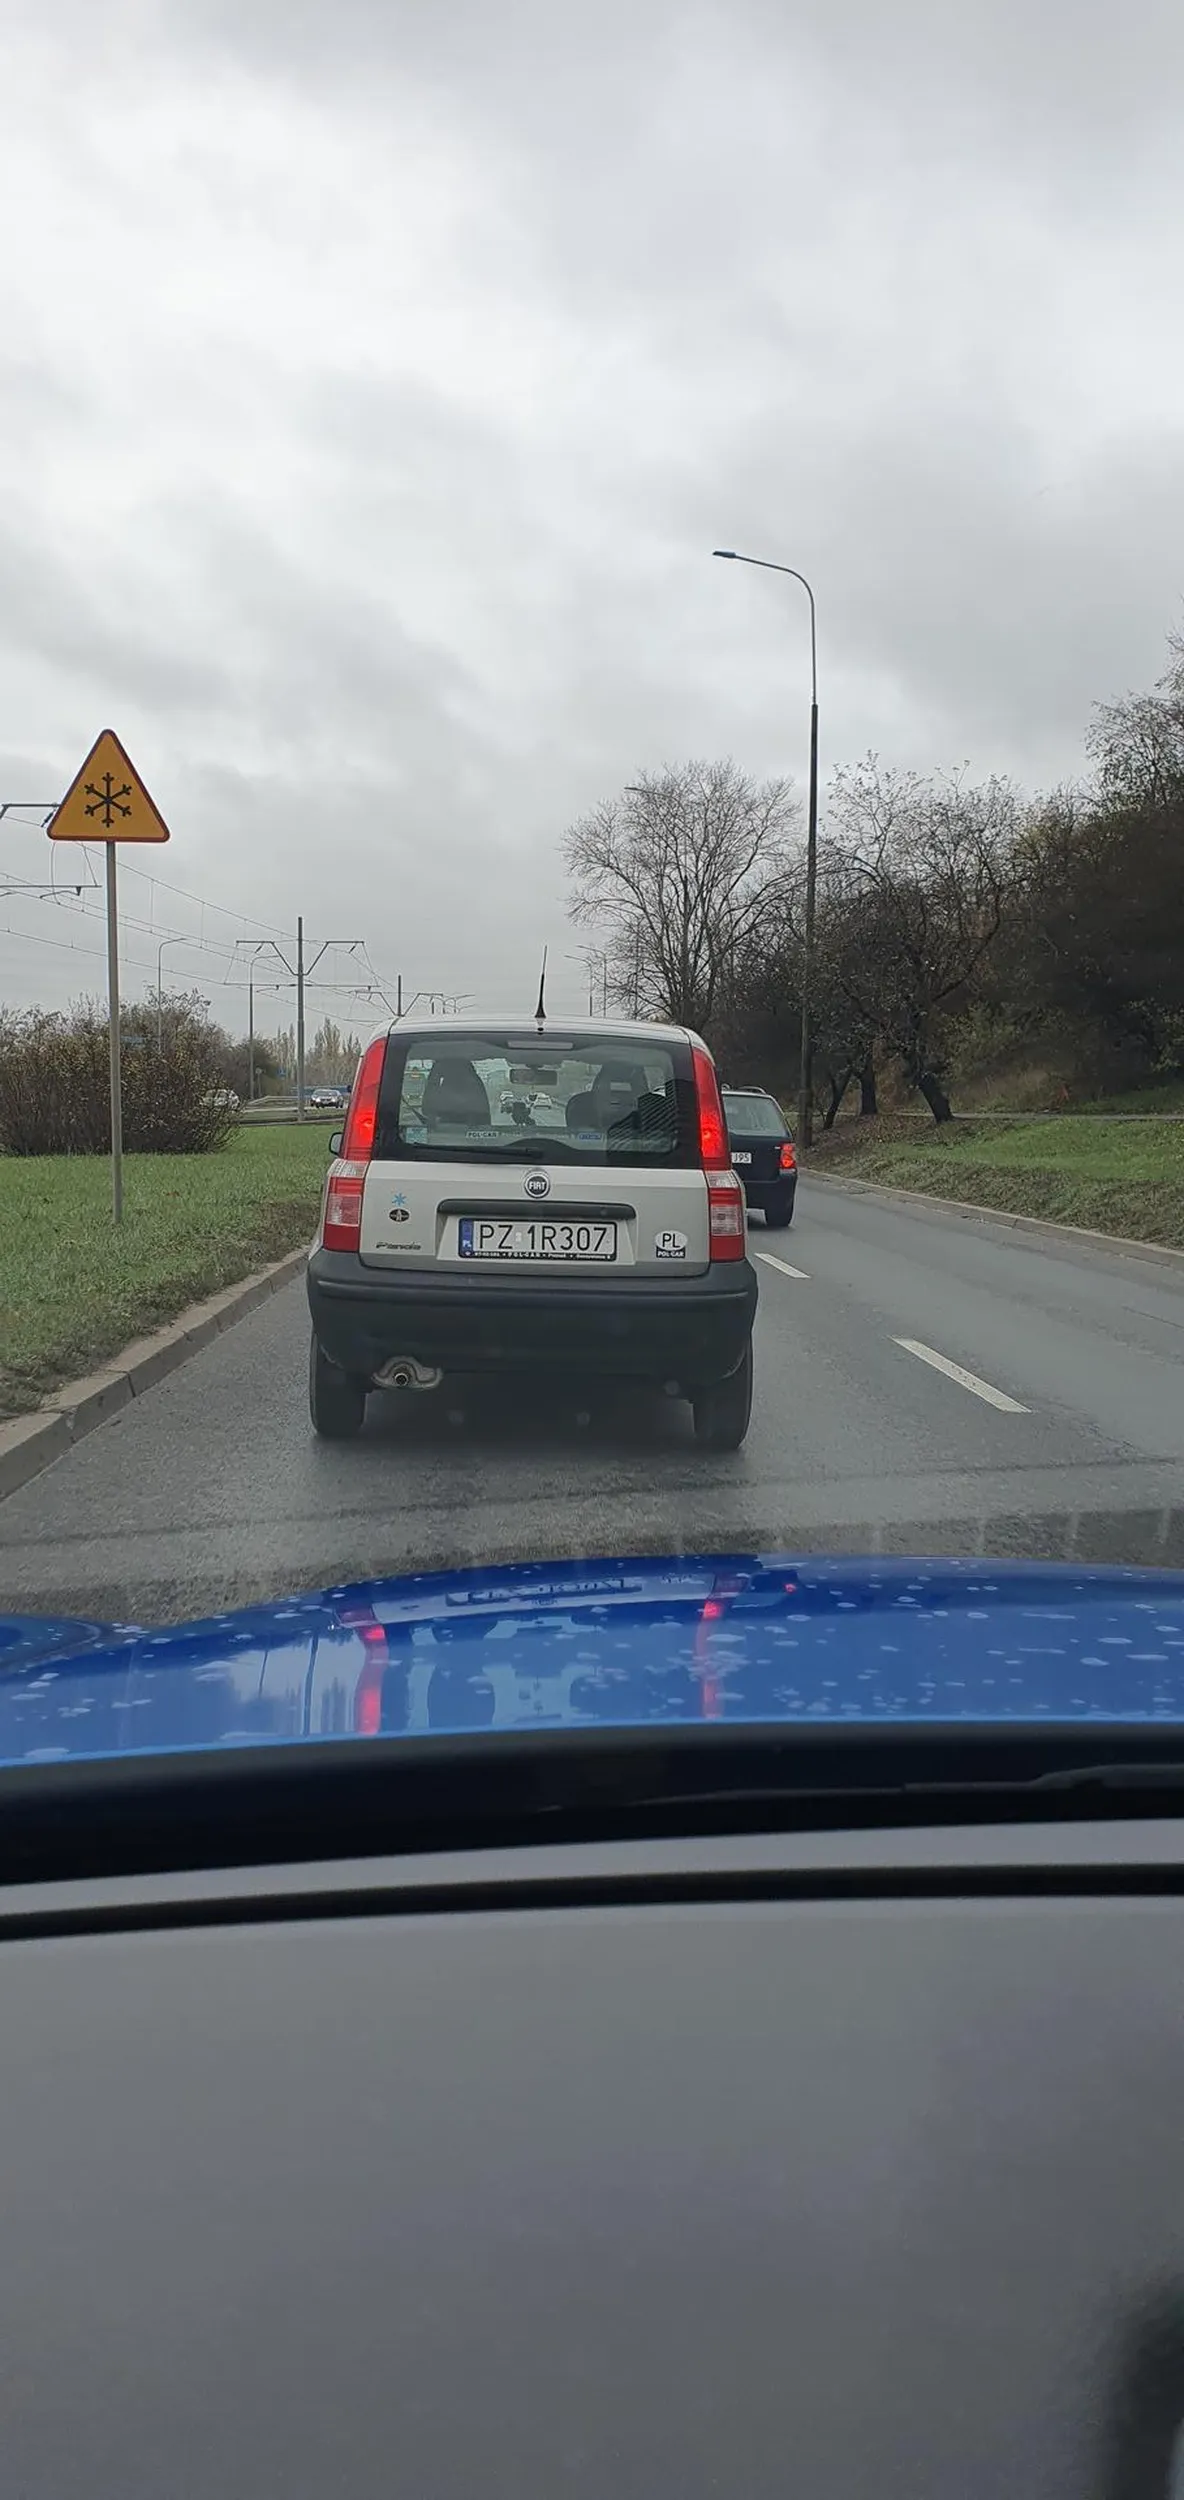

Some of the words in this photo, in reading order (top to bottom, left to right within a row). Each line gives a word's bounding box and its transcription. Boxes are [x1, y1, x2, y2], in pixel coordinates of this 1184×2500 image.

[529, 1181, 546, 1190] FIAT
[480, 1224, 513, 1249] PZ
[527, 1225, 607, 1251] 1R307
[663, 1233, 681, 1248] PL
